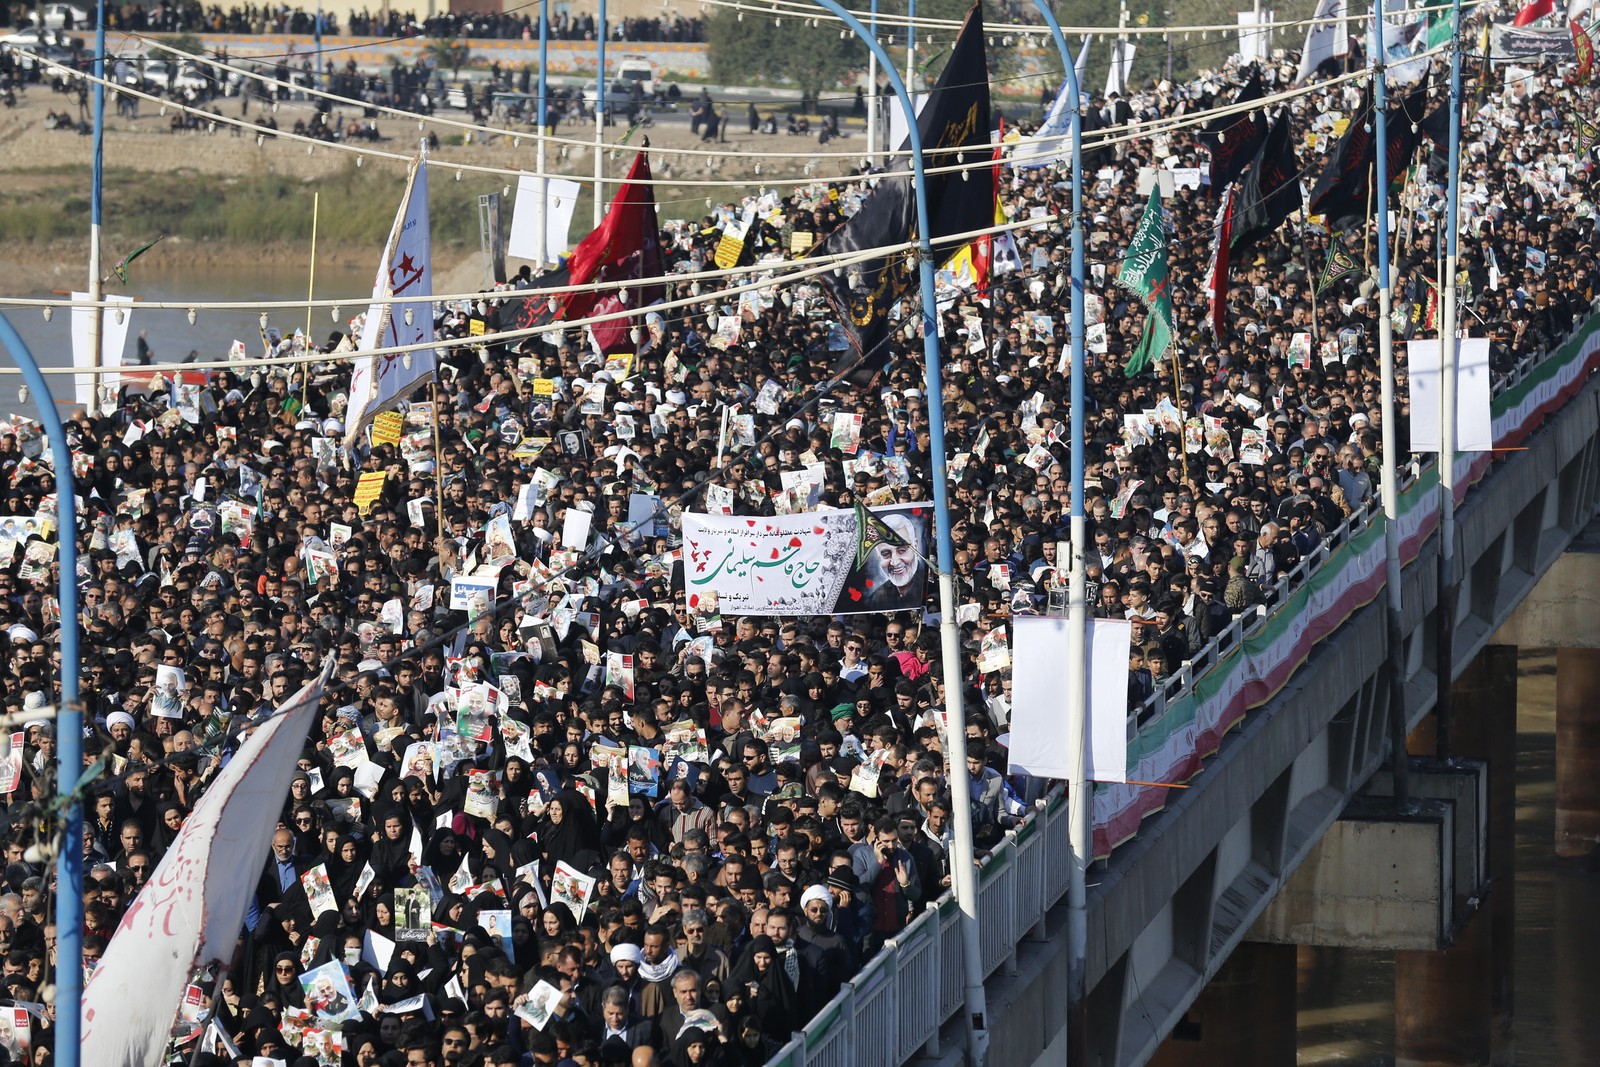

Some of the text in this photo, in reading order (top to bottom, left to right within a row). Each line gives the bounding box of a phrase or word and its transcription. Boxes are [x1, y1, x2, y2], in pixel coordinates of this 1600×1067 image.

[756, 530, 769, 538] سردار
[794, 527, 812, 536] شهادت
[690, 538, 821, 592] حاج قاسم سلیمانی
